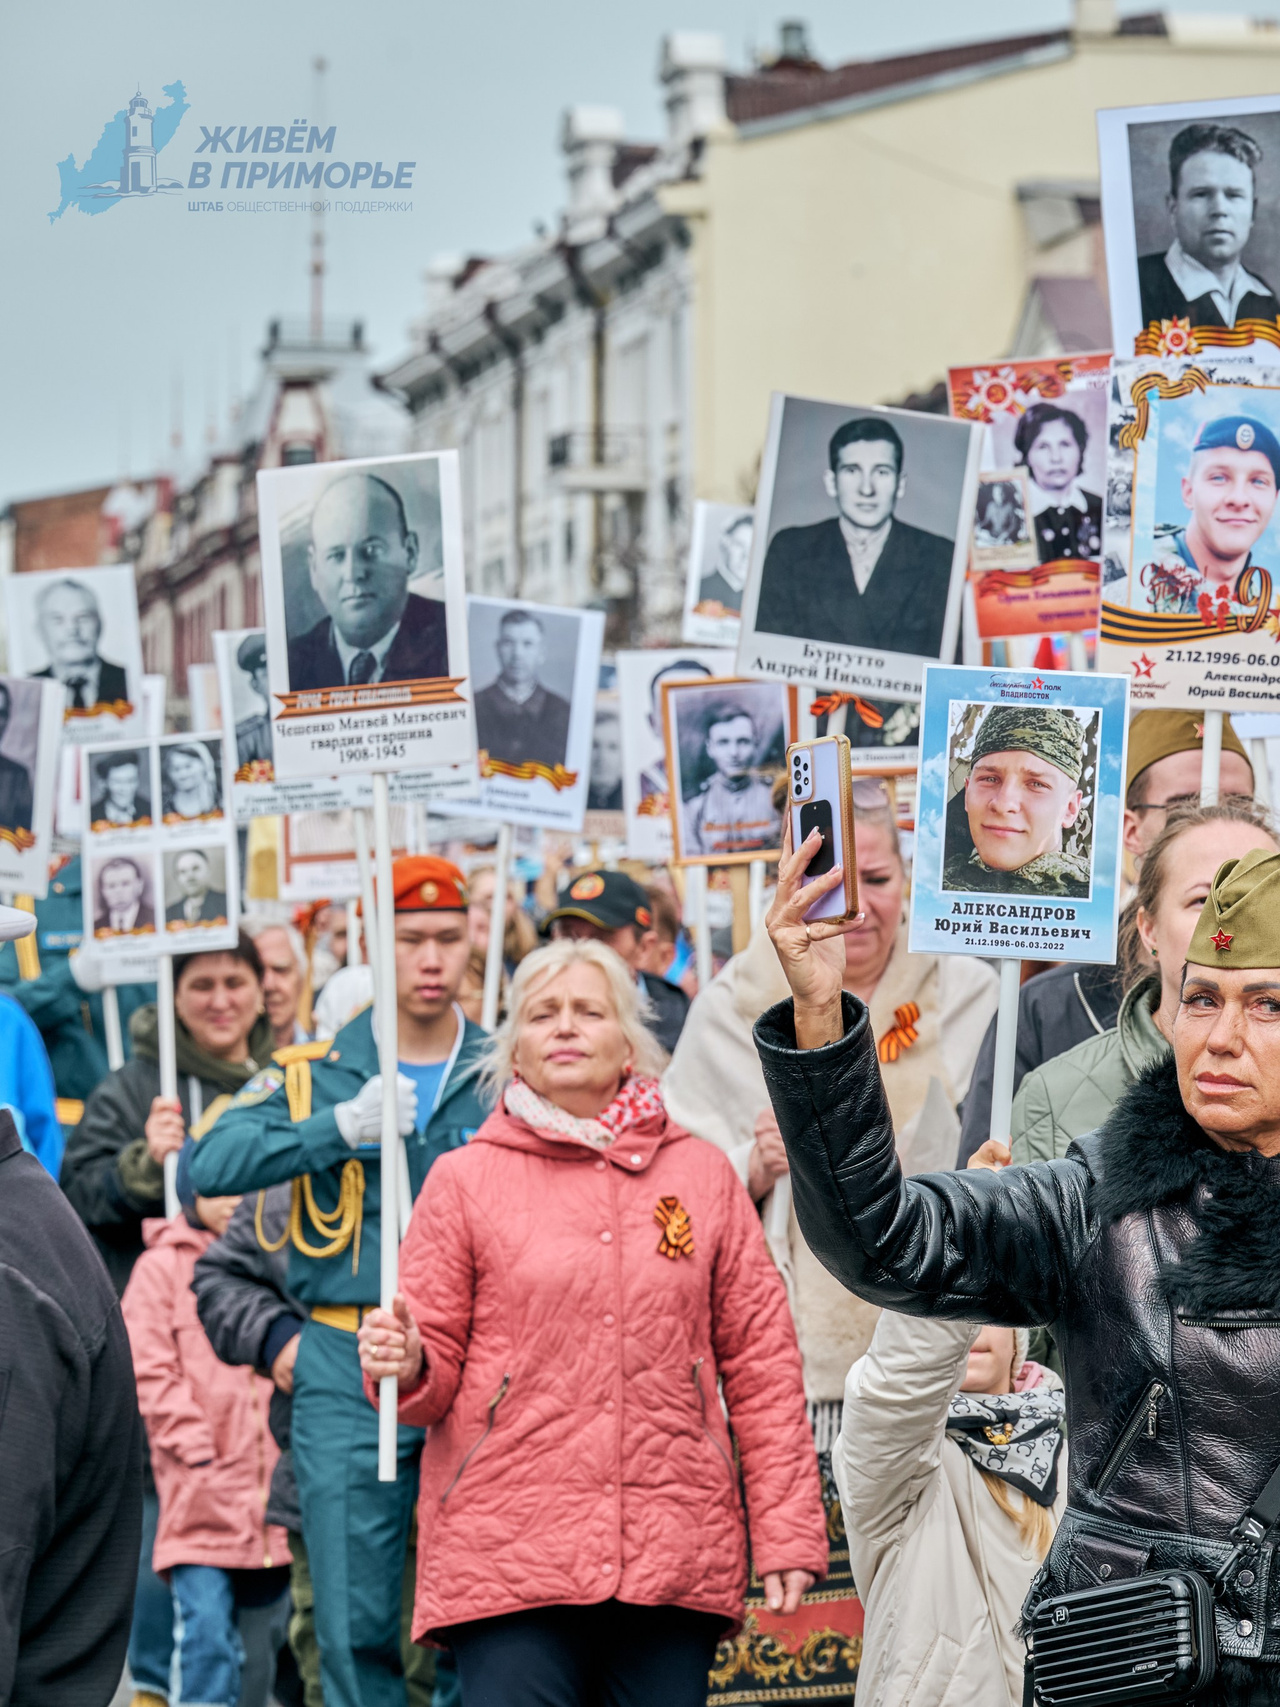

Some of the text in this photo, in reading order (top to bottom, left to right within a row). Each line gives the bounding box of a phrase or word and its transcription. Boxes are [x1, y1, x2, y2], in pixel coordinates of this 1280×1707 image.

[803, 643, 885, 669] Бургутто
[751, 656, 818, 678] Андрей
[1000, 690, 1049, 699] Владивосток
[1188, 687, 1225, 698] Юрий
[277, 707, 467, 738] Чешенко Матвей Матвеевич
[311, 730, 432, 751] гвардии старшина
[340, 744, 406, 763] 1908-1945
[951, 902, 1076, 921] АЛЕКСАНДРОВ
[935, 919, 1091, 939] Юрий Васильевич
[965, 938, 1064, 950] 21.12.1996-06.03.2022
